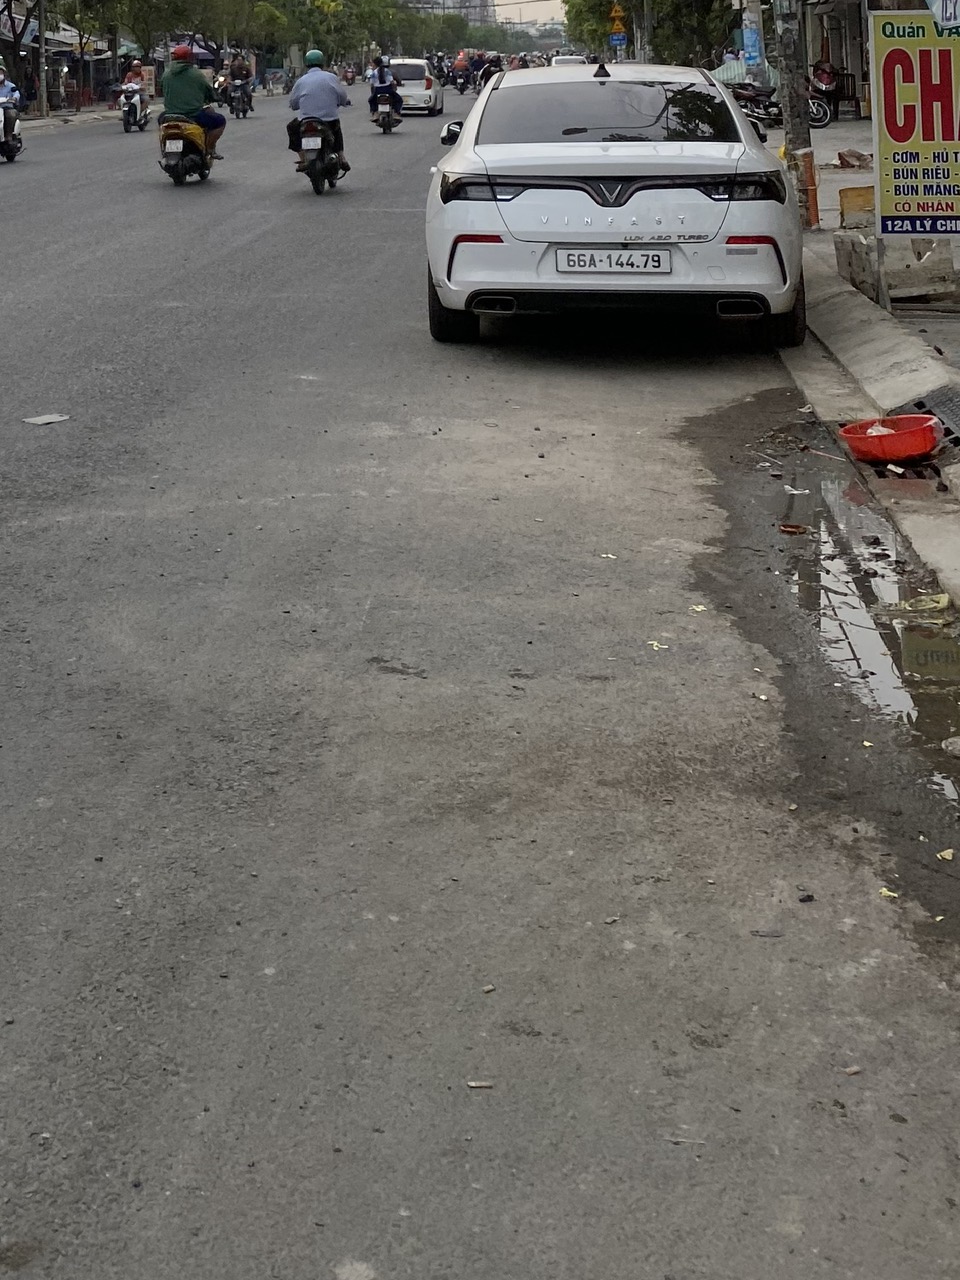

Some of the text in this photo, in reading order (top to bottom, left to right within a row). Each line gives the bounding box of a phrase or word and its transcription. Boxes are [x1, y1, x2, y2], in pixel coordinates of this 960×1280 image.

[881, 21, 926, 38] Quán
[882, 48, 960, 143] CH
[892, 150, 920, 163] CƠM
[893, 165, 950, 180] BÚN RIÊU
[894, 182, 919, 196] BÚN
[894, 199, 911, 212] CÓ
[541, 215, 685, 226] VINFAST
[885, 220, 912, 231] 12A
[916, 218, 932, 231] LÝ
[566, 253, 661, 269] 66A-144.79
